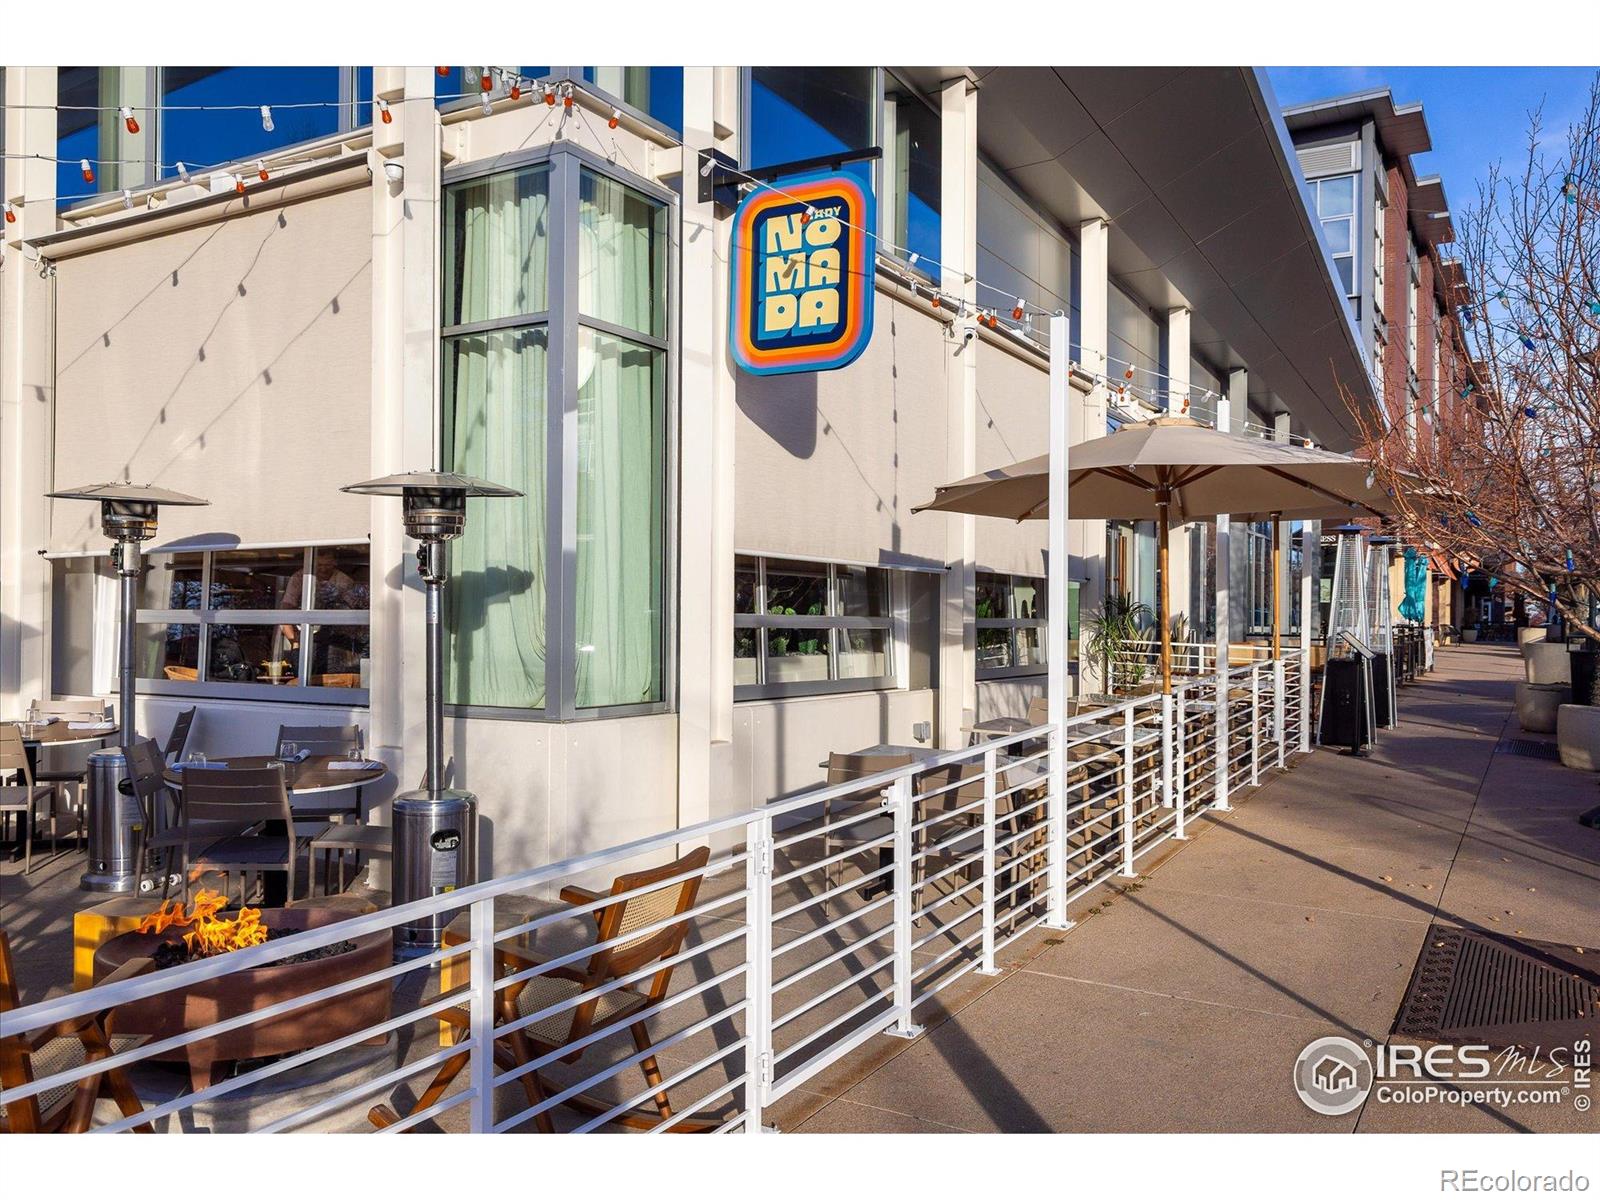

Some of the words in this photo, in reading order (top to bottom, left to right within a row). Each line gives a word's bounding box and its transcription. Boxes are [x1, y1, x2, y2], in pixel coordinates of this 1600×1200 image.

[765, 213, 842, 254] NO
[765, 247, 841, 293] MA
[764, 288, 840, 333] DA
